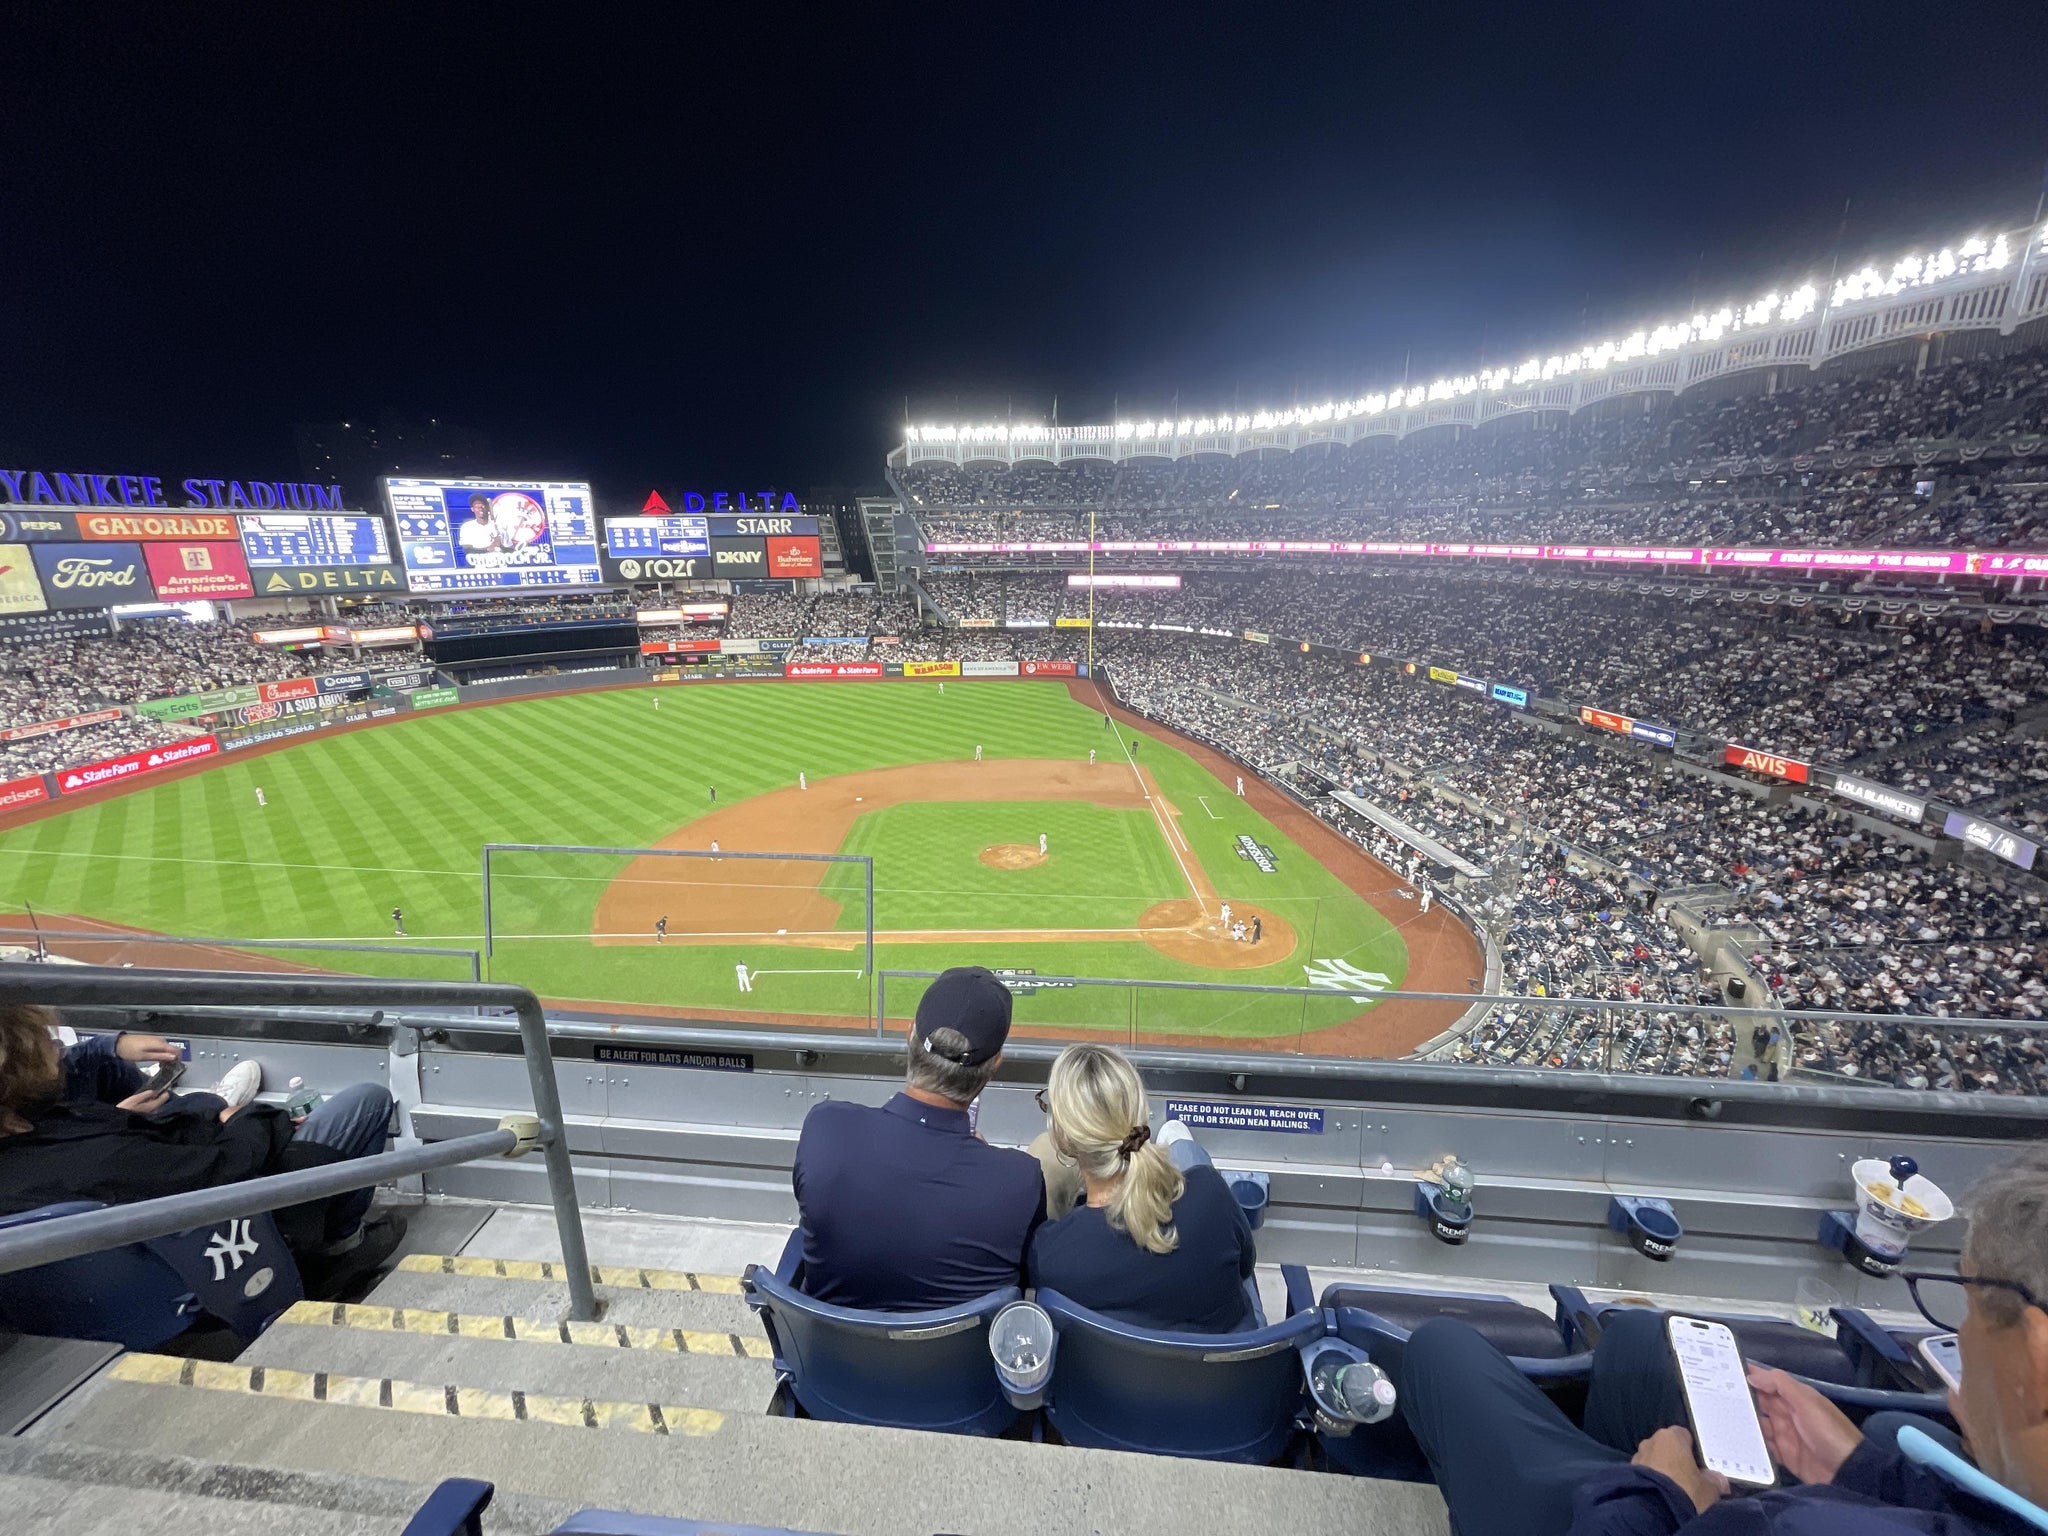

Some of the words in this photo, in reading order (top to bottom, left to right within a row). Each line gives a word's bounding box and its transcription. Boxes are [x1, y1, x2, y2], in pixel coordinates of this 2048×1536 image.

[0, 470, 168, 508] YANKEE
[183, 478, 344, 511] STADIUM
[683, 491, 800, 513] DELTA
[20, 521, 62, 531] PEPSI
[89, 517, 230, 536] GATORADE
[736, 518, 792, 534] STARR
[716, 551, 762, 564] DKNY
[1876, 554, 1903, 566] THE
[52, 558, 136, 588] Ford
[644, 559, 696, 578] razr
[168, 573, 236, 585] America's
[299, 569, 397, 590] DELTA
[158, 585, 190, 595] Best
[192, 582, 249, 593] Network
[335, 675, 362, 685] coupa
[170, 702, 199, 714] Eats
[286, 702, 292, 714] A
[295, 697, 317, 712] SUB
[345, 712, 368, 723] STARR
[1743, 752, 1787, 776] AVIS
[1837, 779, 1864, 797] LOLA
[1302, 959, 1393, 1004] NY
[600, 1050, 612, 1060] BE
[613, 1050, 640, 1061] ALERT
[641, 1052, 657, 1062] FOR
[658, 1053, 681, 1064] BATS
[683, 1054, 717, 1067] AND/OR
[718, 1056, 746, 1068] BALLS
[1169, 1103, 1198, 1113] PLEASE
[1200, 1105, 1211, 1113] DO
[1213, 1106, 1230, 1115] NOT
[1231, 1107, 1252, 1116] LEAN
[1254, 1109, 1267, 1118] ON,
[1269, 1109, 1296, 1119] REACH
[1297, 1111, 1321, 1121] OVER,
[1178, 1114, 1192, 1122] SIT
[1193, 1115, 1205, 1123] ON
[1207, 1115, 1217, 1124] OR
[1219, 1116, 1245, 1126] STAND
[1247, 1118, 1269, 1127] NEAR
[1270, 1119, 1310, 1130] RAILINGS.
[203, 1219, 260, 1281] NY
